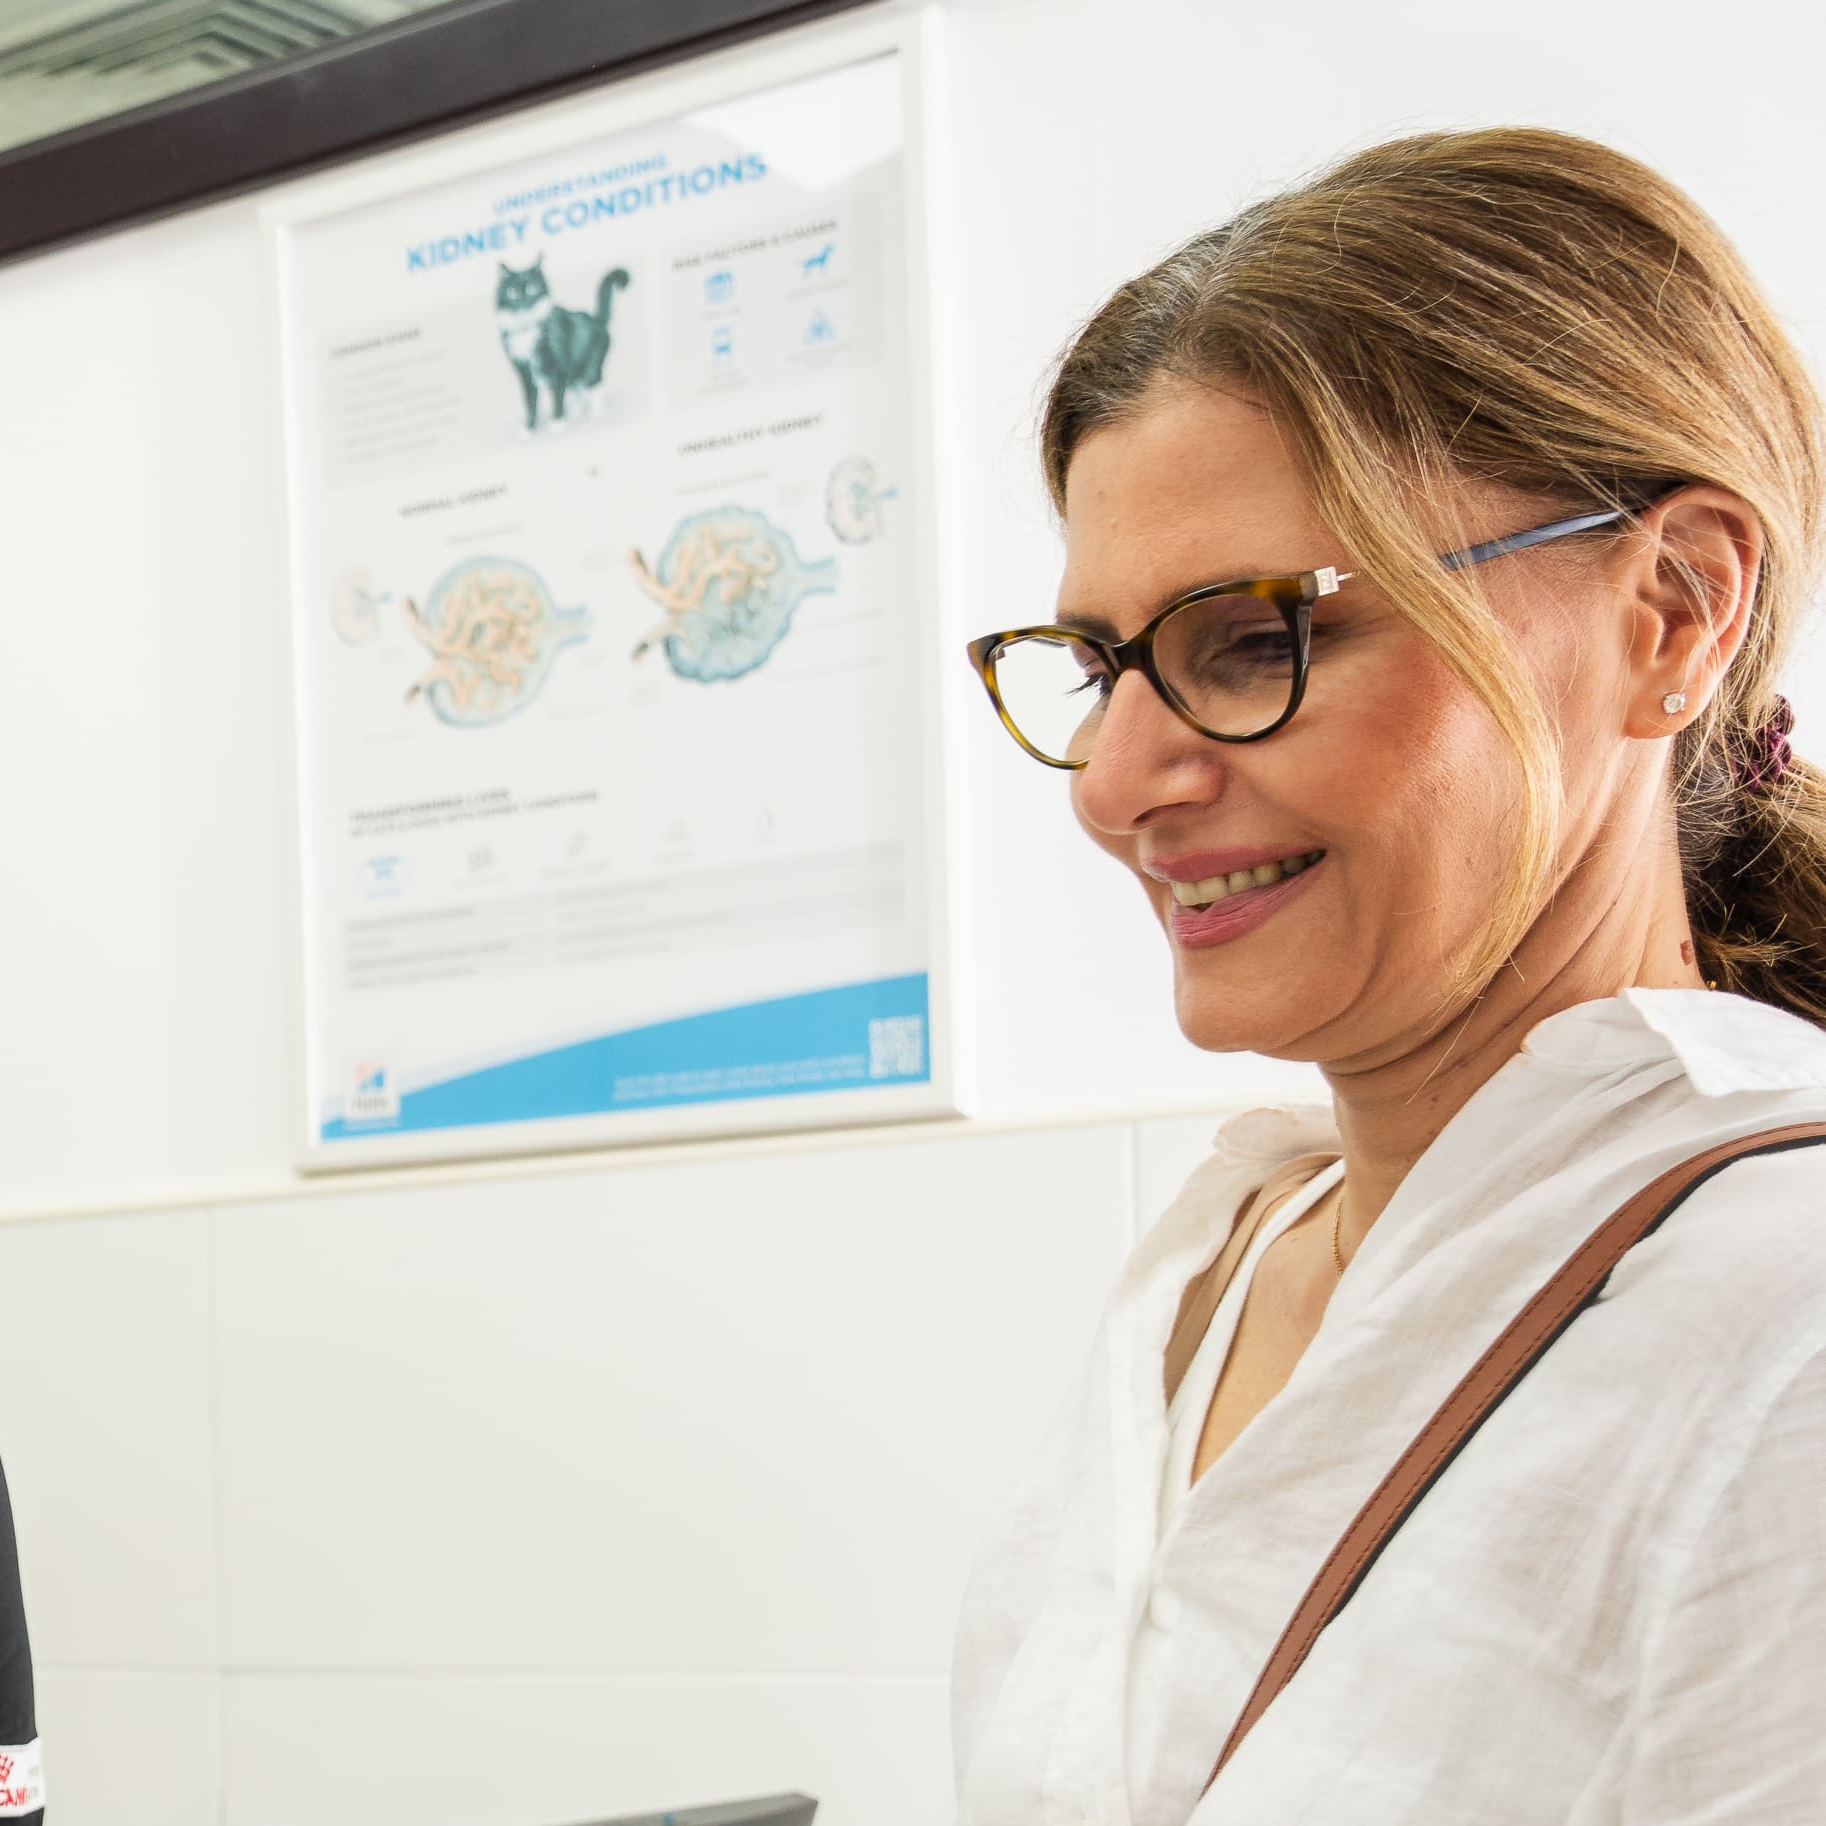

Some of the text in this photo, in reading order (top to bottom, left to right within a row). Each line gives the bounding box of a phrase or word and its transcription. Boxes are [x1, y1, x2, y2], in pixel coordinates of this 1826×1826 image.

[406, 152, 769, 273] KIDNEY CONDITIONS
[494, 153, 667, 215] UNDERSTANDING
